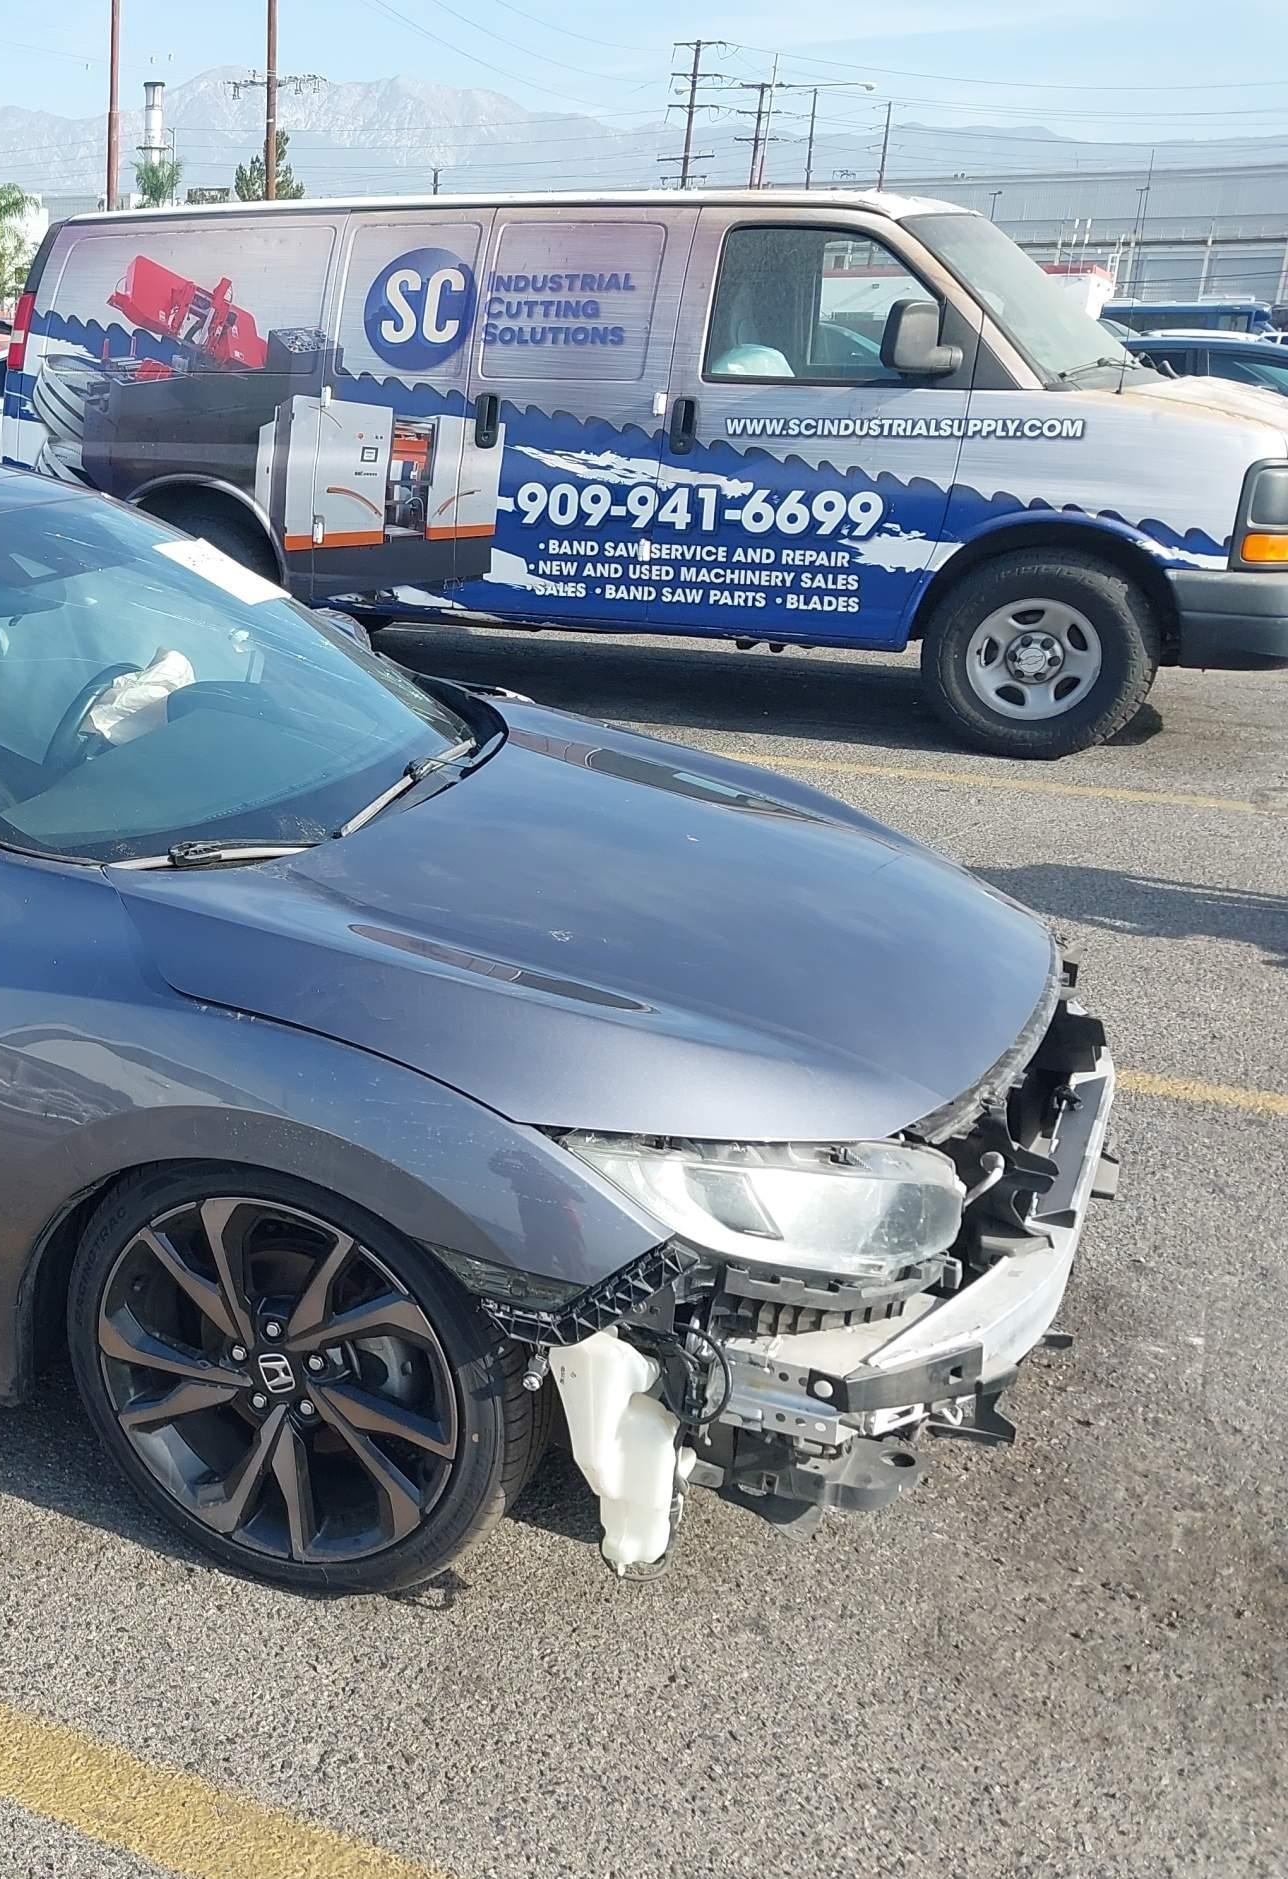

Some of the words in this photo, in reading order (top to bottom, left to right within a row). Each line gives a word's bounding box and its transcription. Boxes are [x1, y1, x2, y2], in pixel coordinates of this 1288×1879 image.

[487, 271, 636, 293] INDUSTRIAL
[381, 269, 465, 344] SC
[485, 296, 601, 319] CUTTING
[482, 322, 625, 346] SOLUTIONS
[725, 418, 1085, 438] WWW.SCINDUSTRIALSUPPLY.COM
[516, 482, 885, 536] 909-941-6699
[548, 539, 599, 556] BAND
[650, 543, 727, 561] SERVICE
[732, 547, 776, 564] AND
[781, 549, 850, 567] REPAIR
[538, 560, 578, 576] NEW
[582, 562, 623, 578] AND
[628, 564, 674, 581] USED
[680, 566, 796, 588] MACHINERY
[800, 572, 859, 591] SALES
[534, 581, 587, 598] SALES
[605, 584, 656, 601] BAND
[661, 587, 704, 604] SAW
[709, 589, 767, 608] PARTS
[785, 593, 860, 613] BLADES
